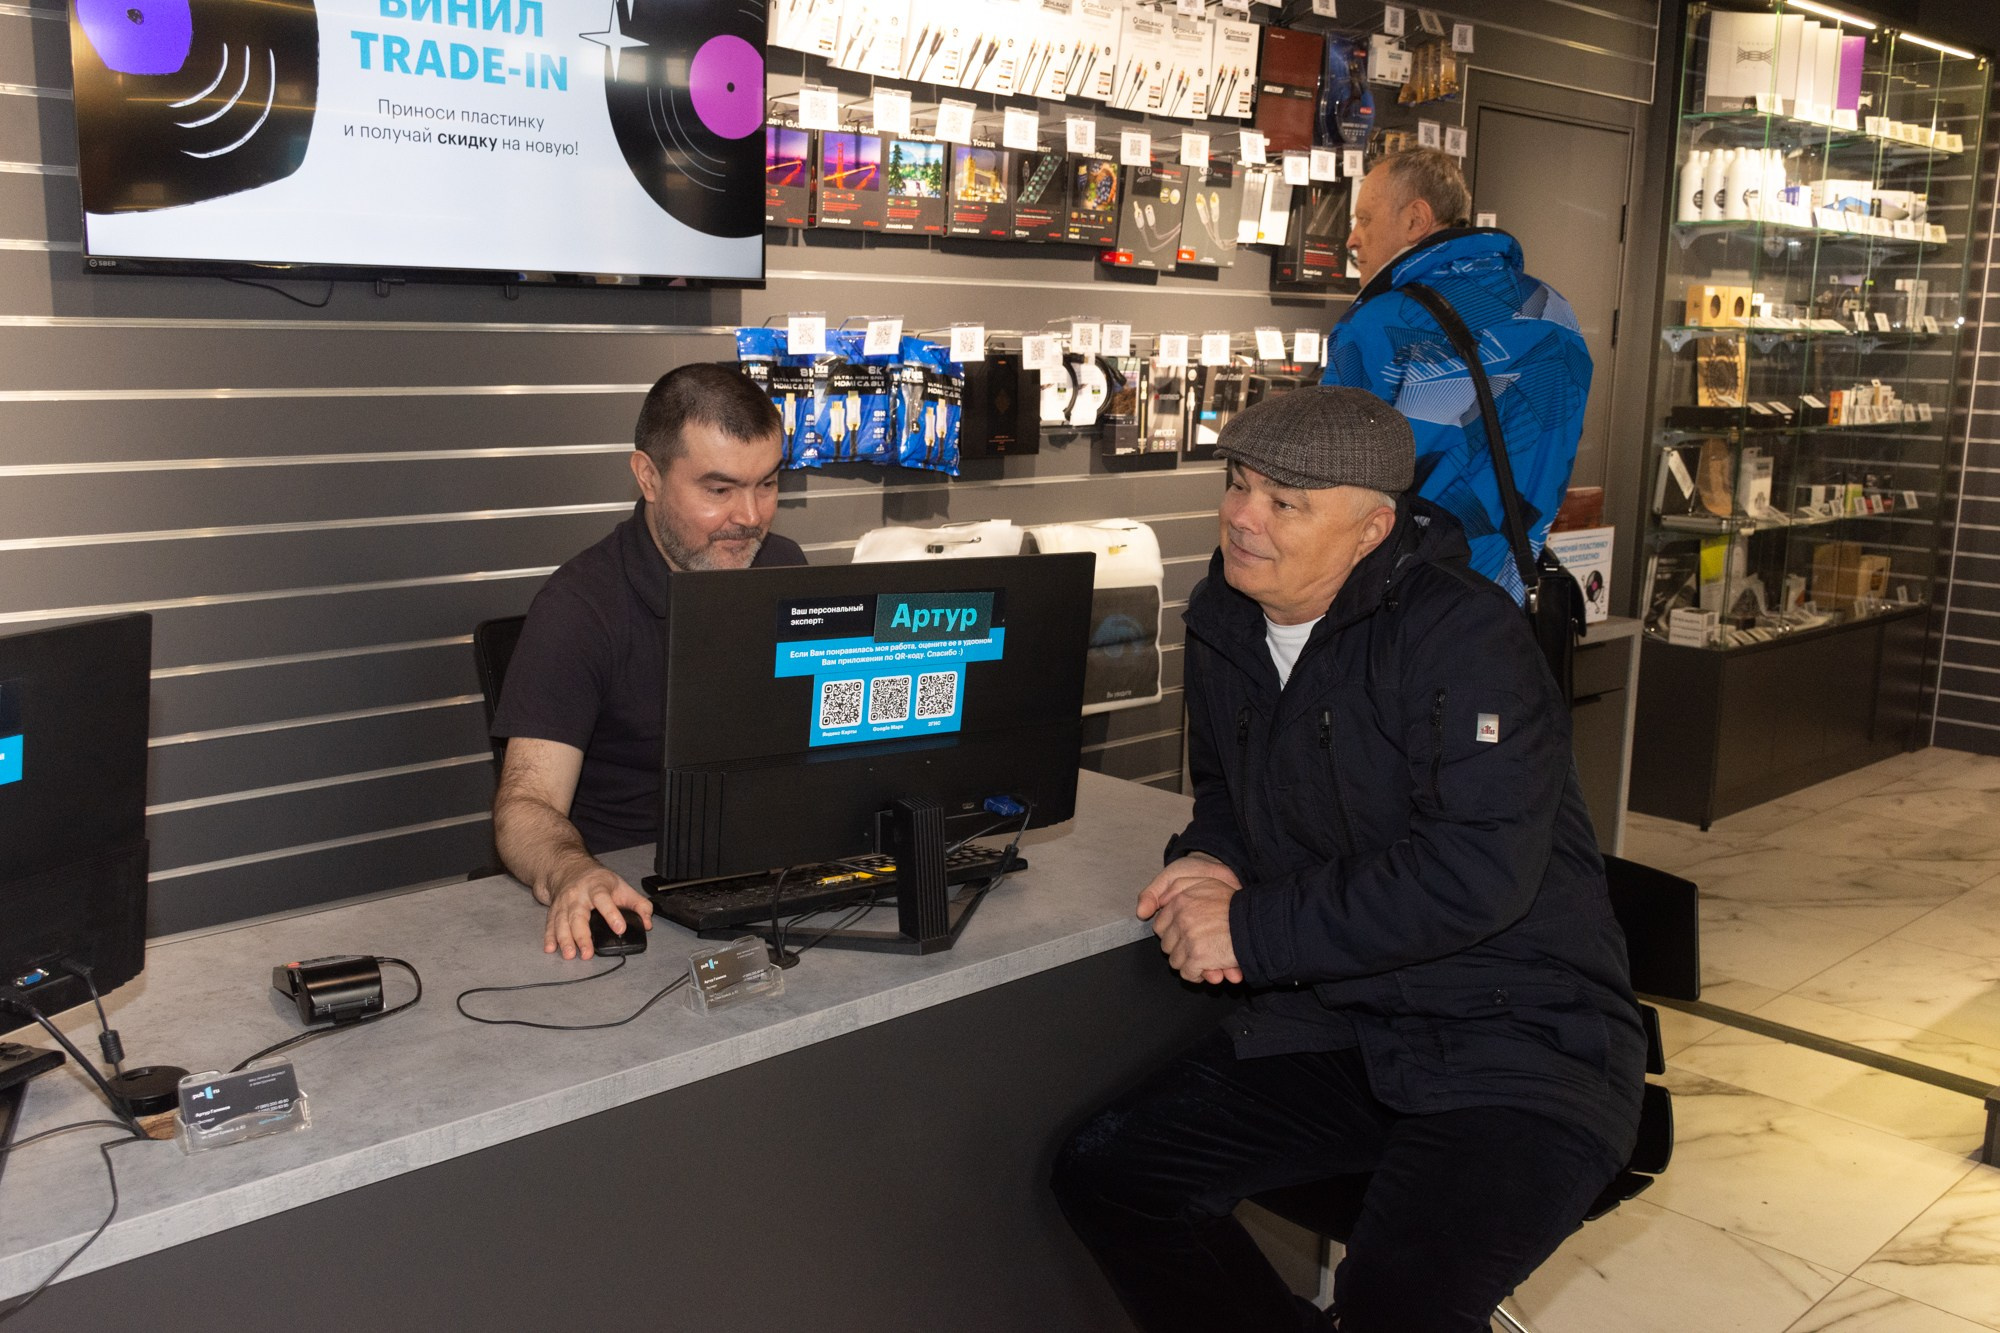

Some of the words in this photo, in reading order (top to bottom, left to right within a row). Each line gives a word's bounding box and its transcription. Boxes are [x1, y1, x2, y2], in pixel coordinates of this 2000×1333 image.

[351, 30, 568, 92] TRADE-IN
[378, 98, 455, 121] Приноси
[461, 110, 545, 133] пластинку
[344, 124, 354, 137] и
[360, 124, 433, 144] получай
[437, 132, 498, 152] скидку
[502, 137, 521, 151] на
[525, 141, 580, 157] новую!
[773, 382, 792, 390] HDMI
[791, 607, 808, 615] Ваш
[808, 603, 864, 615] персональный
[890, 603, 978, 633] Артур
[790, 617, 824, 626] эксперт:
[790, 650, 809, 659] Если
[810, 649, 825, 657] Вам
[826, 646, 874, 656] понравилась
[889, 642, 917, 652] работа,
[918, 640, 948, 649] оцените
[821, 658, 837, 666] Вам
[837, 655, 884, 665] приложении
[894, 652, 926, 660] QR-коду.
[926, 648, 958, 658] Спасибо
